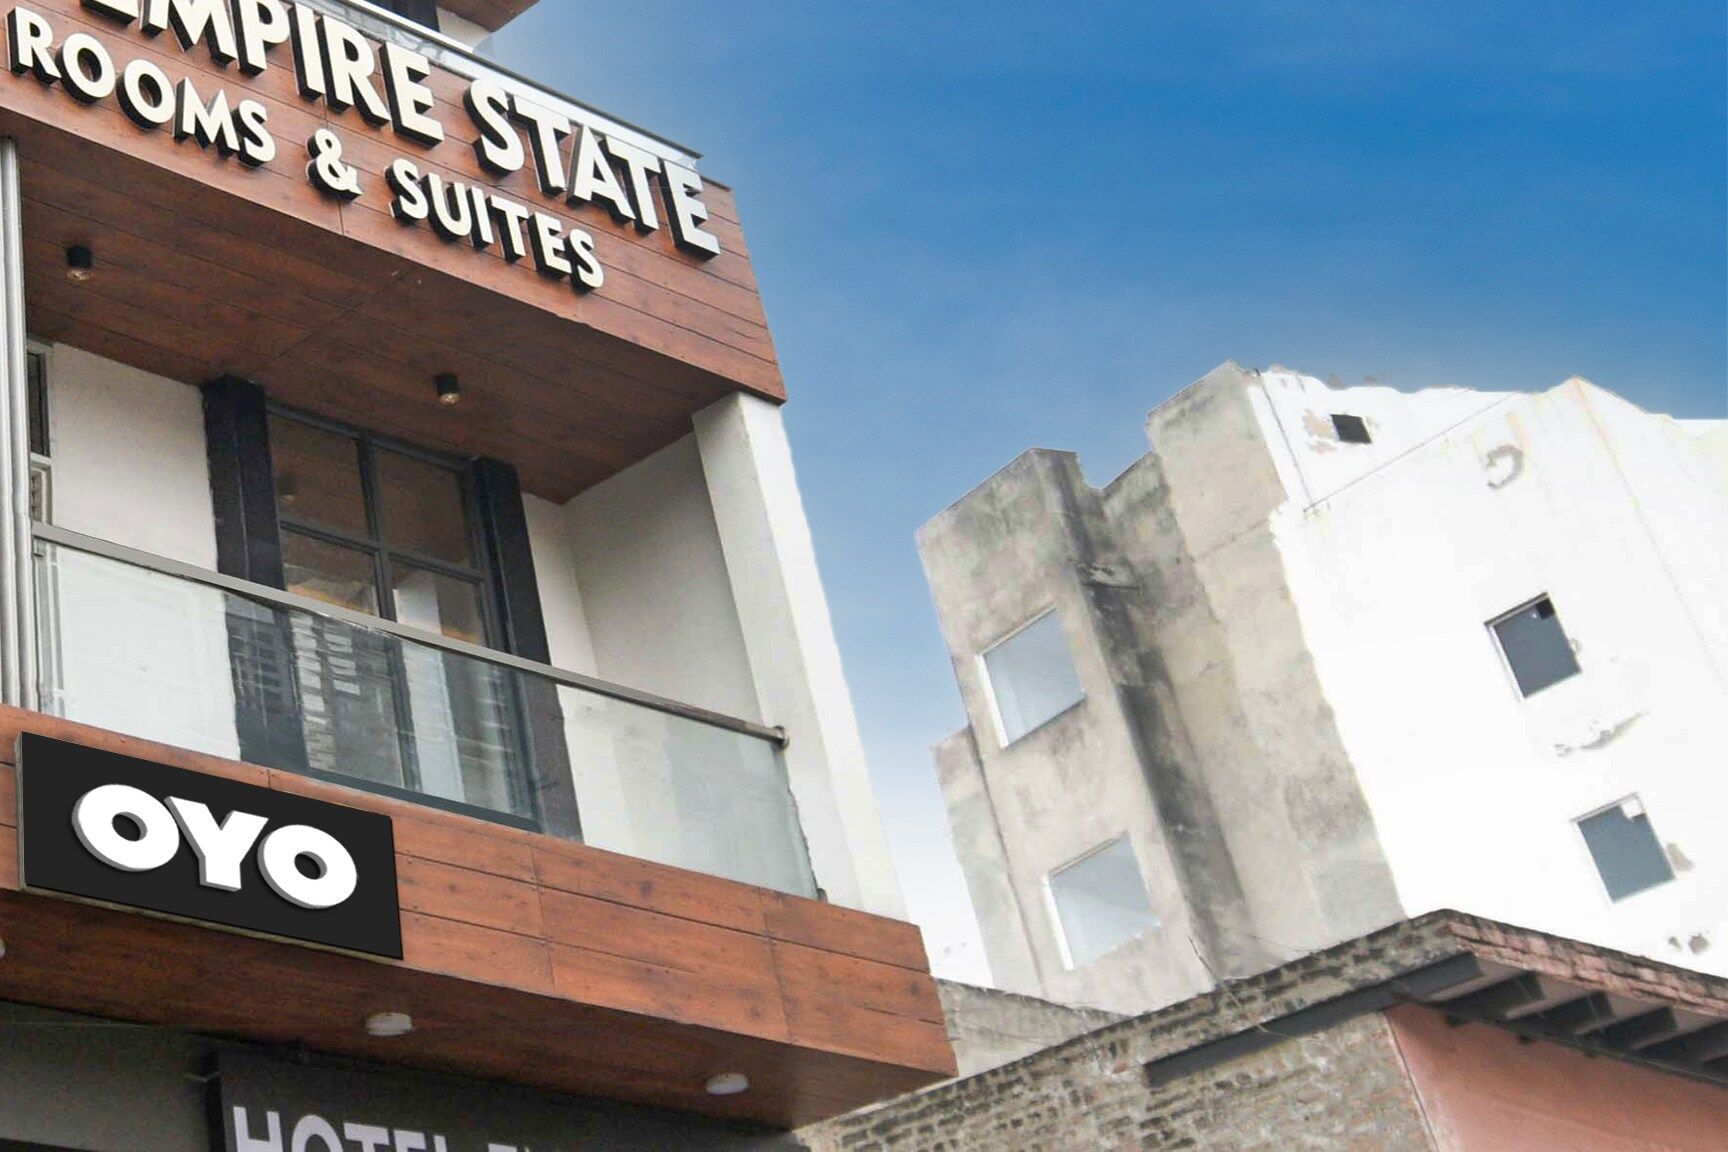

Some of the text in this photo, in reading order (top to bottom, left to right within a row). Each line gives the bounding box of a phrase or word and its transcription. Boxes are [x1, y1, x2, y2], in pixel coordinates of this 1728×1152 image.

[6, 6, 604, 293] ROOMS & SUITES
[463, 78, 720, 261] STATE
[72, 783, 358, 910] OYO
